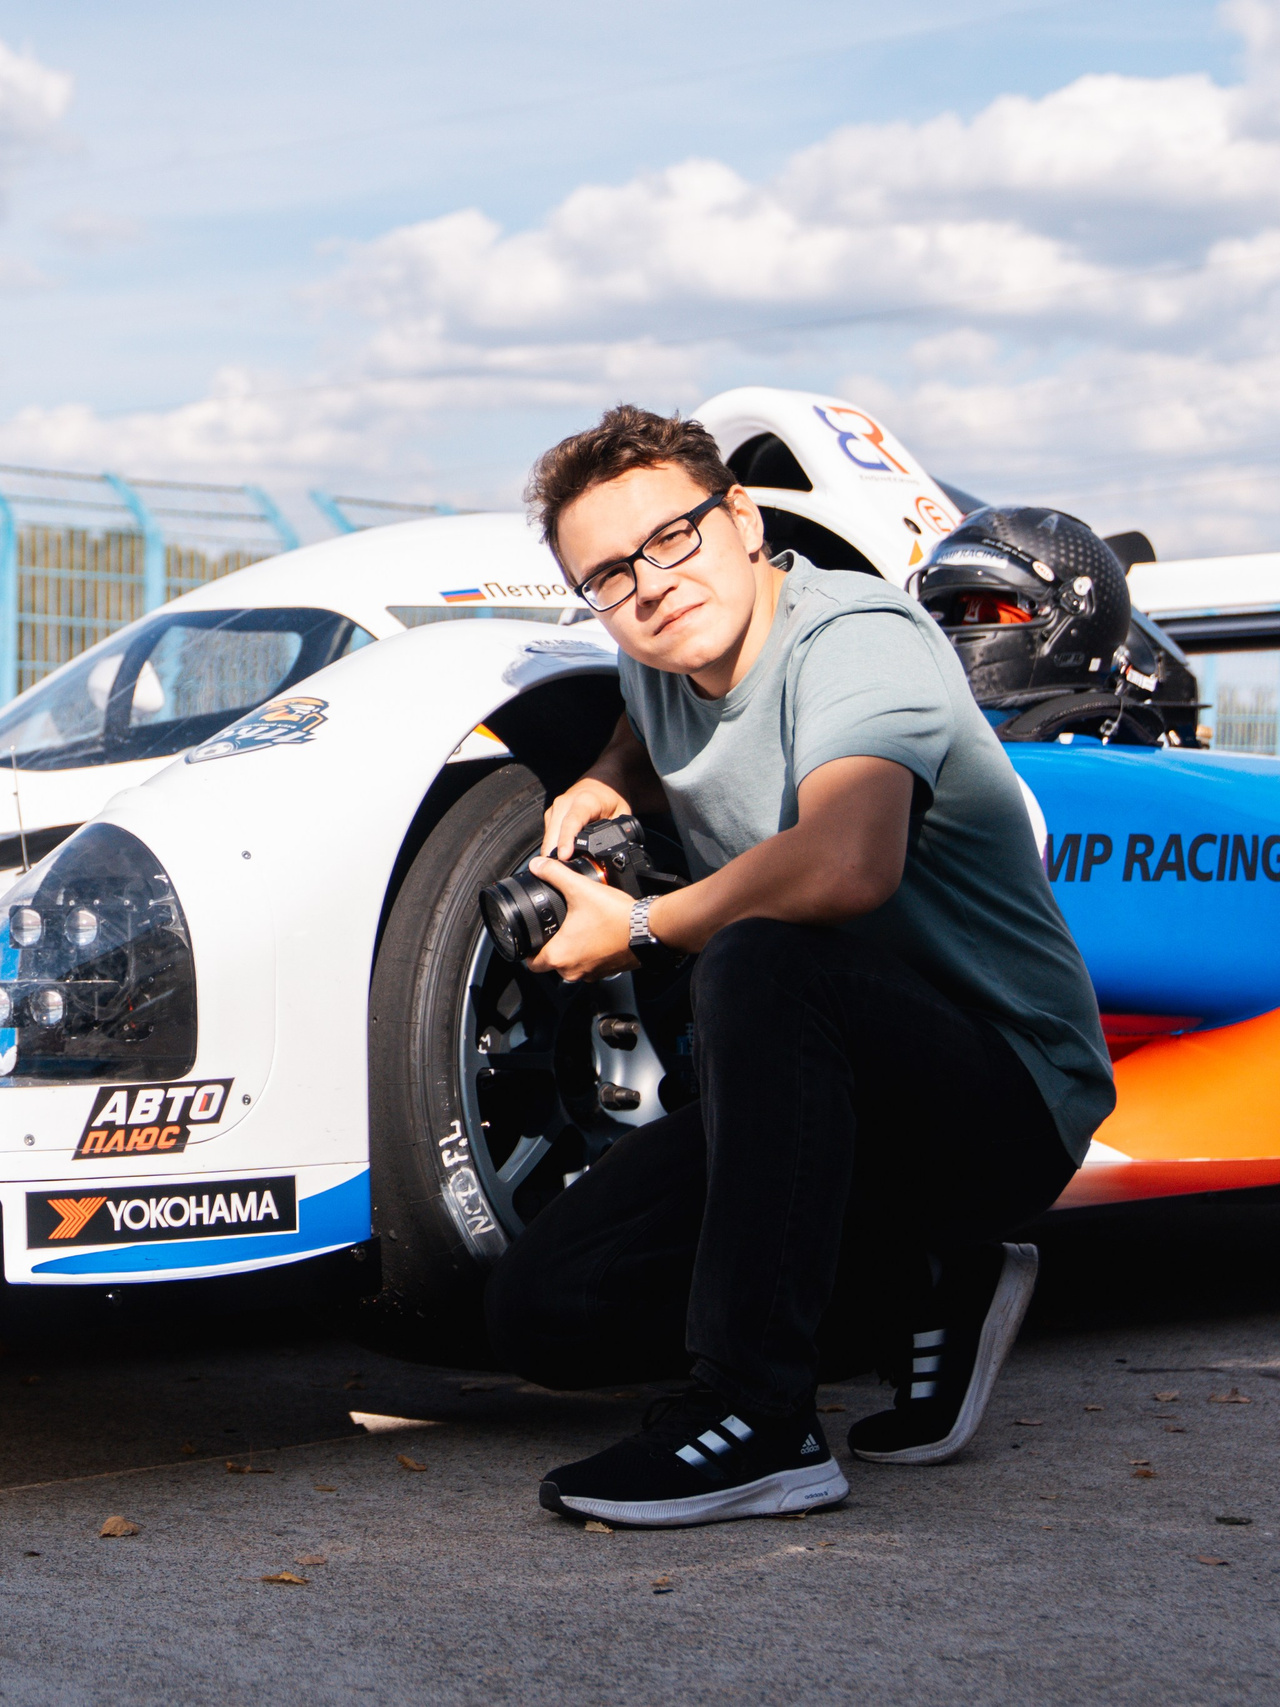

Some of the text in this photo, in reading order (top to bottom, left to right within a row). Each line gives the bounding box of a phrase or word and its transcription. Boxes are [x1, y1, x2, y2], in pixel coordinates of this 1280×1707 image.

[483, 581, 572, 600] Петро
[1122, 833, 1280, 882] RACING
[92, 1083, 225, 1127] АВТО
[81, 1124, 181, 1155] ПЛЮС
[106, 1190, 279, 1232] YOKOHAMA
[800, 1444, 820, 1455] adidas
